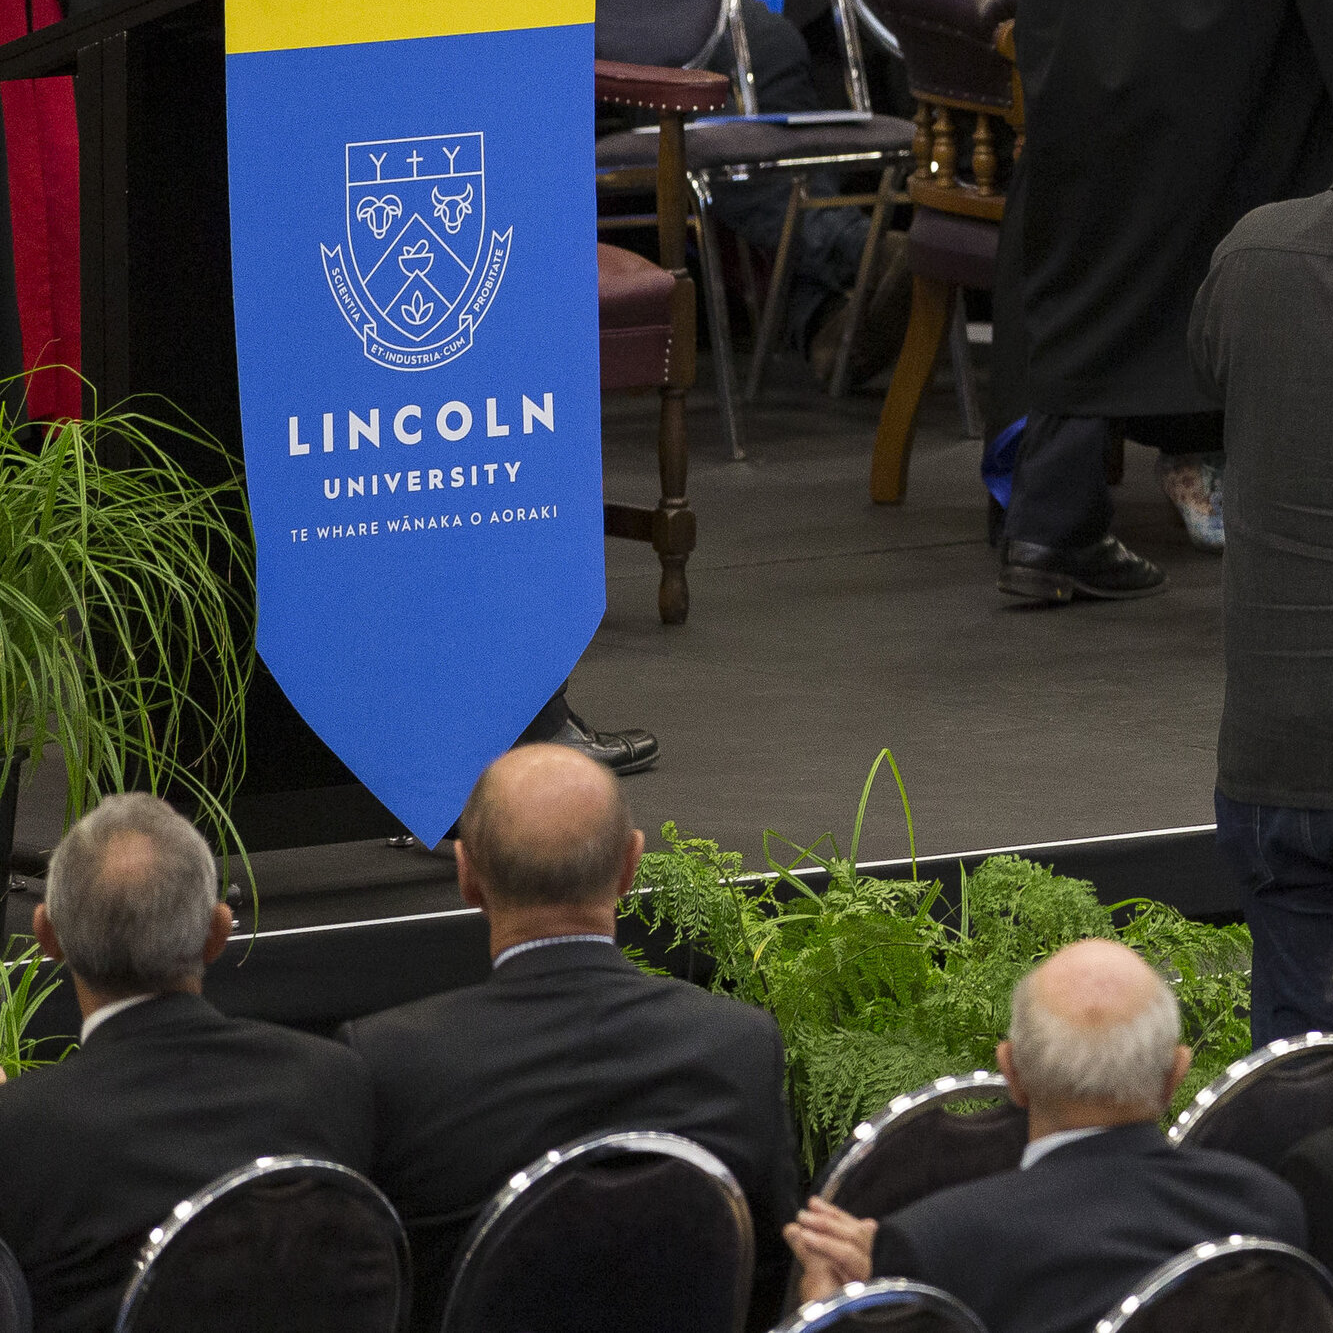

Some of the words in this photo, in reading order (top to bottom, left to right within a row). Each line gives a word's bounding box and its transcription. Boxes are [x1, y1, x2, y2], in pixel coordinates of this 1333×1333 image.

[332, 267, 361, 322] SCIENTIA
[473, 248, 505, 312] PROBITATE
[288, 392, 555, 457] LINCOLN
[323, 461, 521, 500] UNIVERSITY
[290, 528, 308, 543] TE
[316, 521, 379, 540] WHARE
[386, 514, 463, 532] WĀNAKA
[470, 511, 482, 526] O
[489, 505, 557, 524] AORAKI
